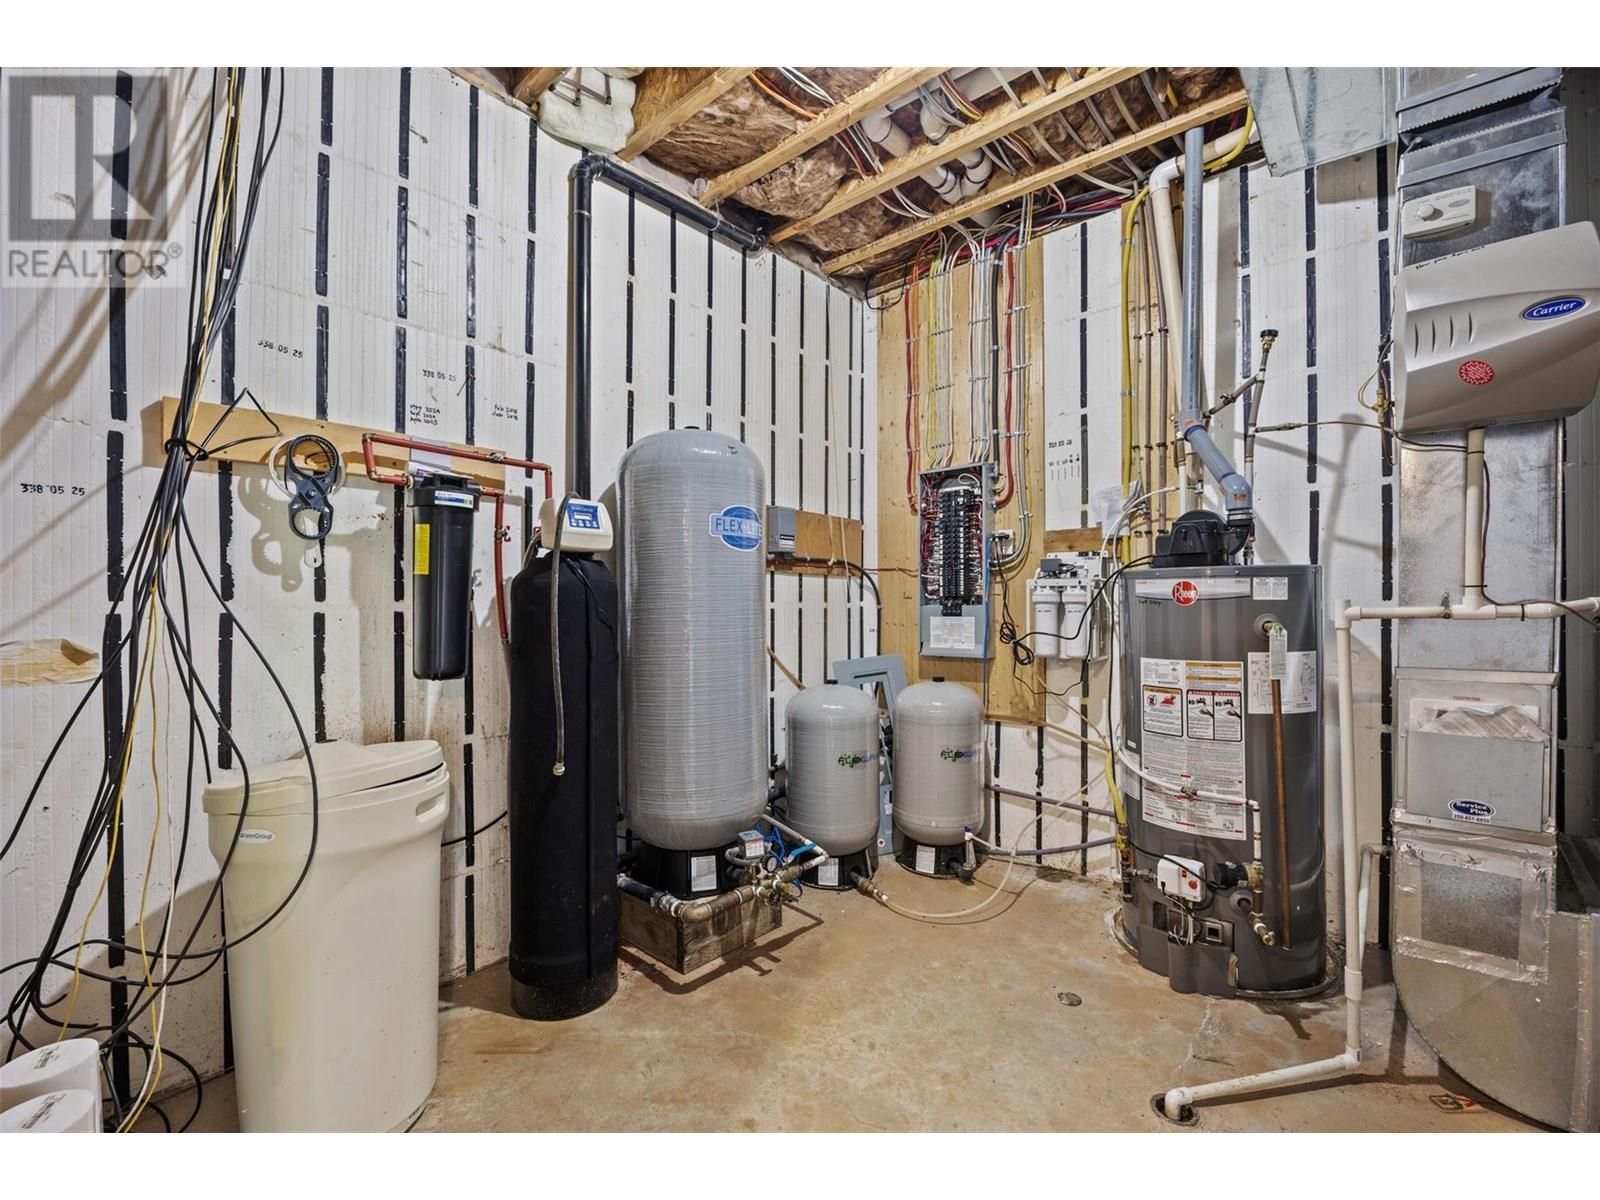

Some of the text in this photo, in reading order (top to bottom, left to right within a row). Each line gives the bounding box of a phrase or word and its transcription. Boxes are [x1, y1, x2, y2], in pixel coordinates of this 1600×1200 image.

[1533, 302, 1576, 316] Carrier
[277, 344, 289, 354] 05
[292, 349, 303, 358] 25
[20, 483, 86, 496] 338 05 25
[1456, 801, 1487, 809] Service
